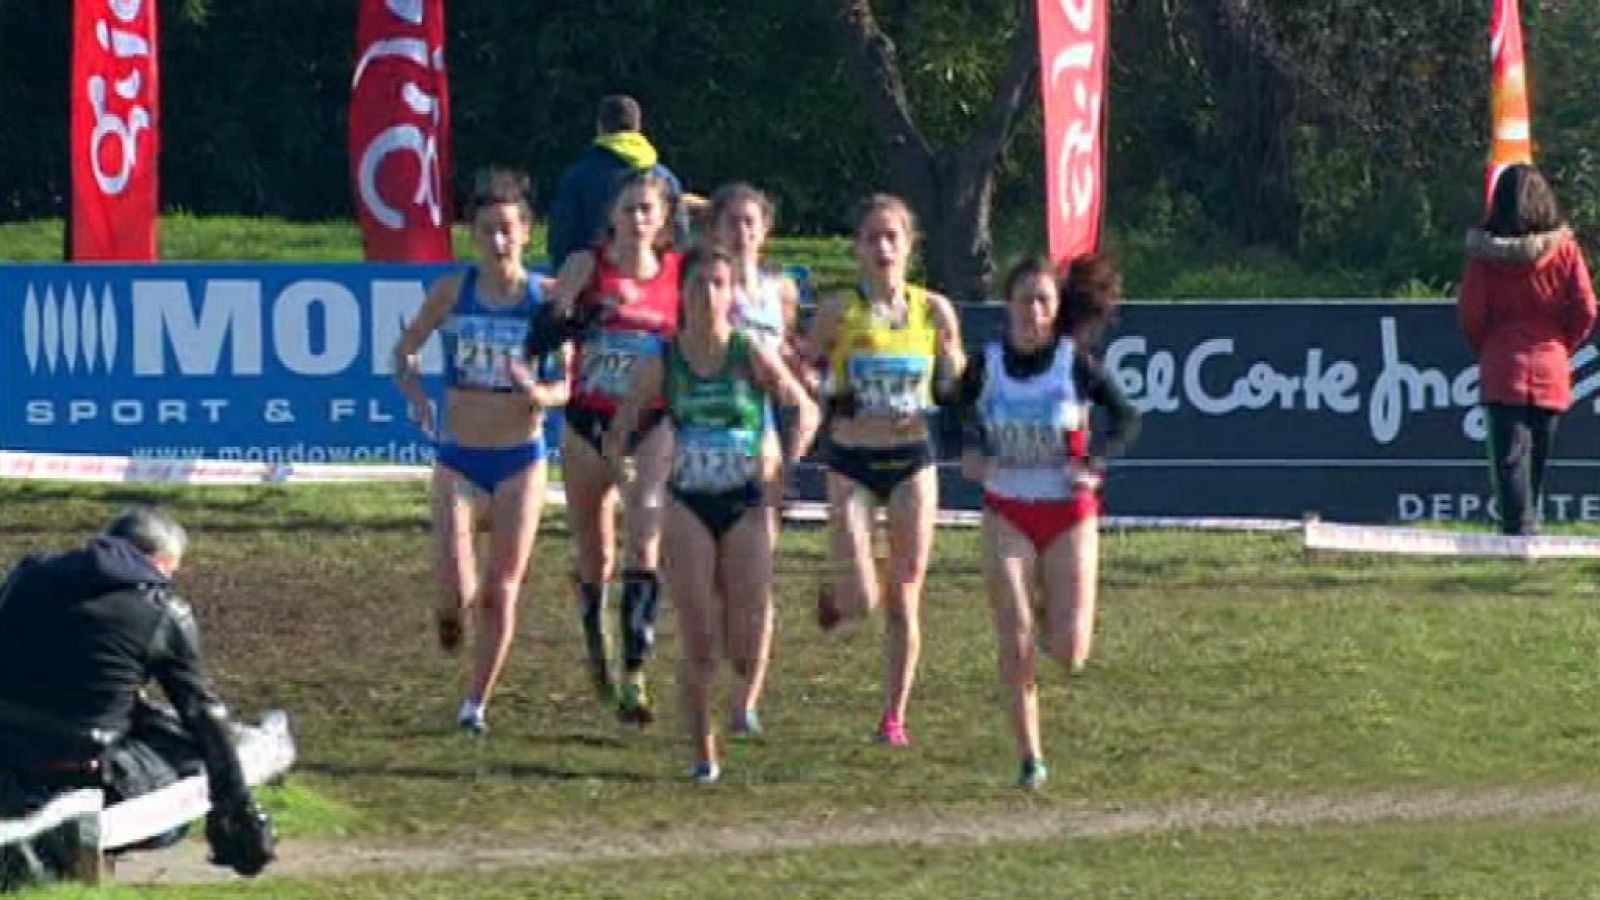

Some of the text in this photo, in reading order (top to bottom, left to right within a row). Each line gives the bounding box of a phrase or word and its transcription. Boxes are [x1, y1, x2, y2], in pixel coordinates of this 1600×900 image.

[1107, 336, 1178, 412] El
[1184, 339, 1360, 414] Corte
[26, 399, 227, 425] SPORT
[264, 400, 295, 424] &
